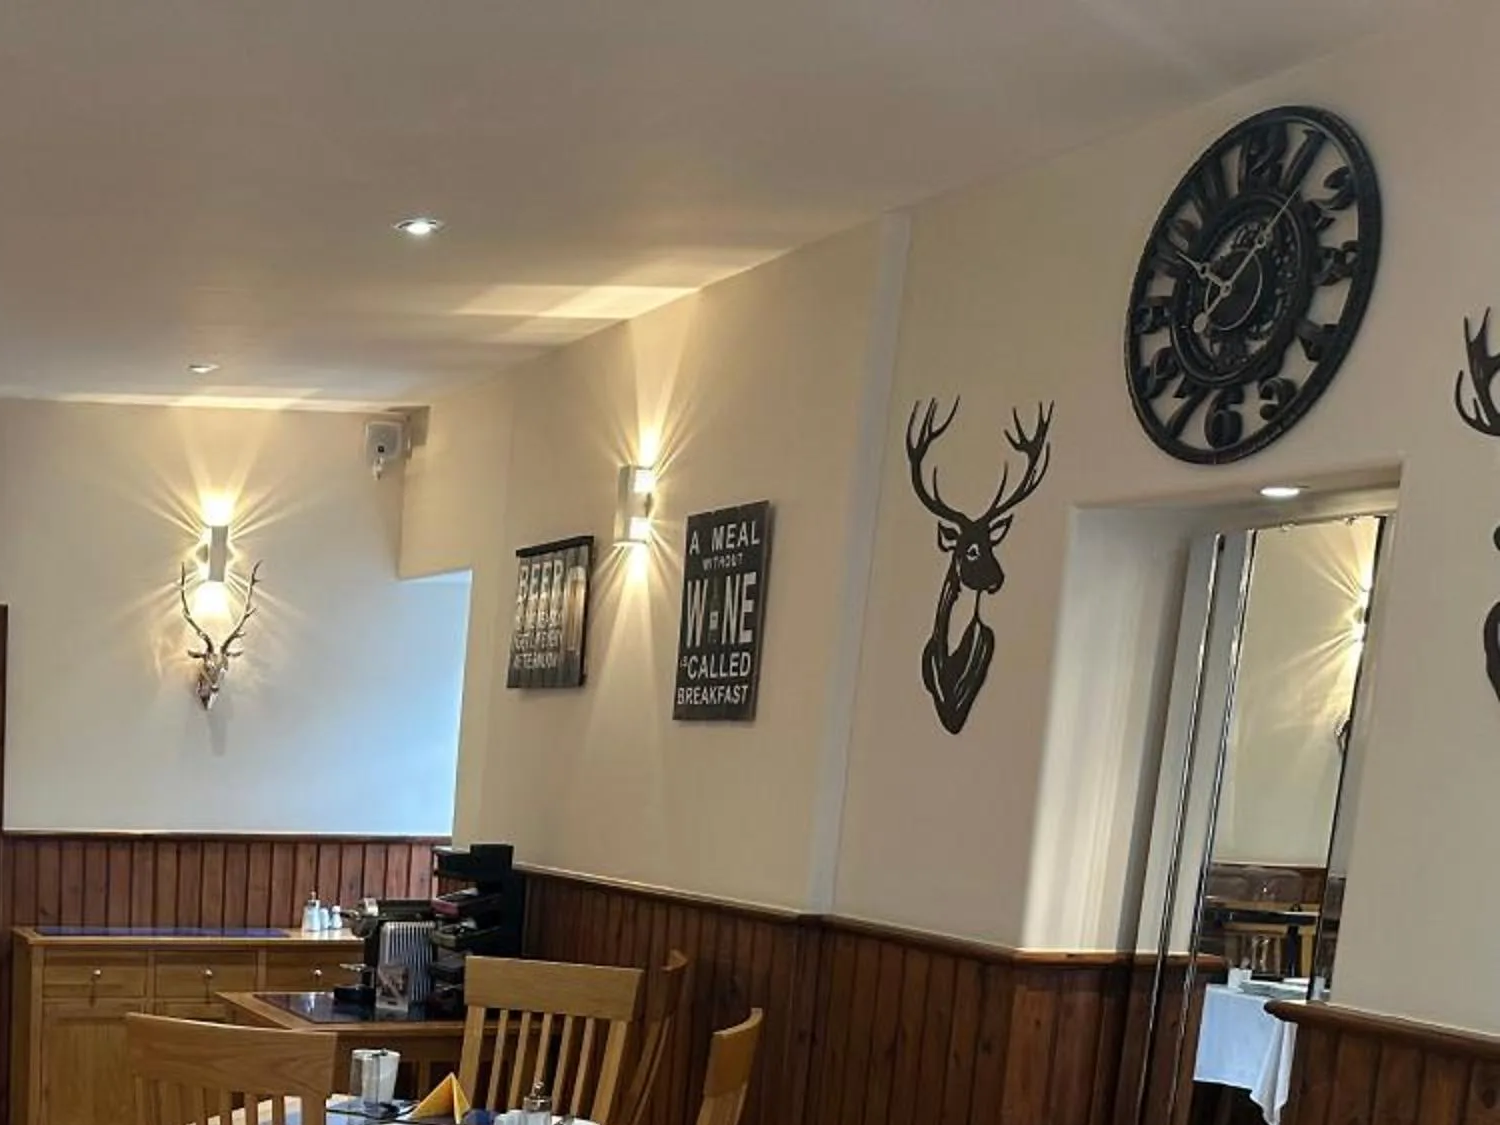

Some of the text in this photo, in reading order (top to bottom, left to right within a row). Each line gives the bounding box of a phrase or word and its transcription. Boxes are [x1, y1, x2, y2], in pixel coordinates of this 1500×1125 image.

[1204, 386, 1243, 448] 6
[689, 520, 760, 556] A MEAL
[518, 559, 564, 600] BEER
[687, 652, 751, 679] CALLED
[677, 684, 748, 705] BREAKFAST
